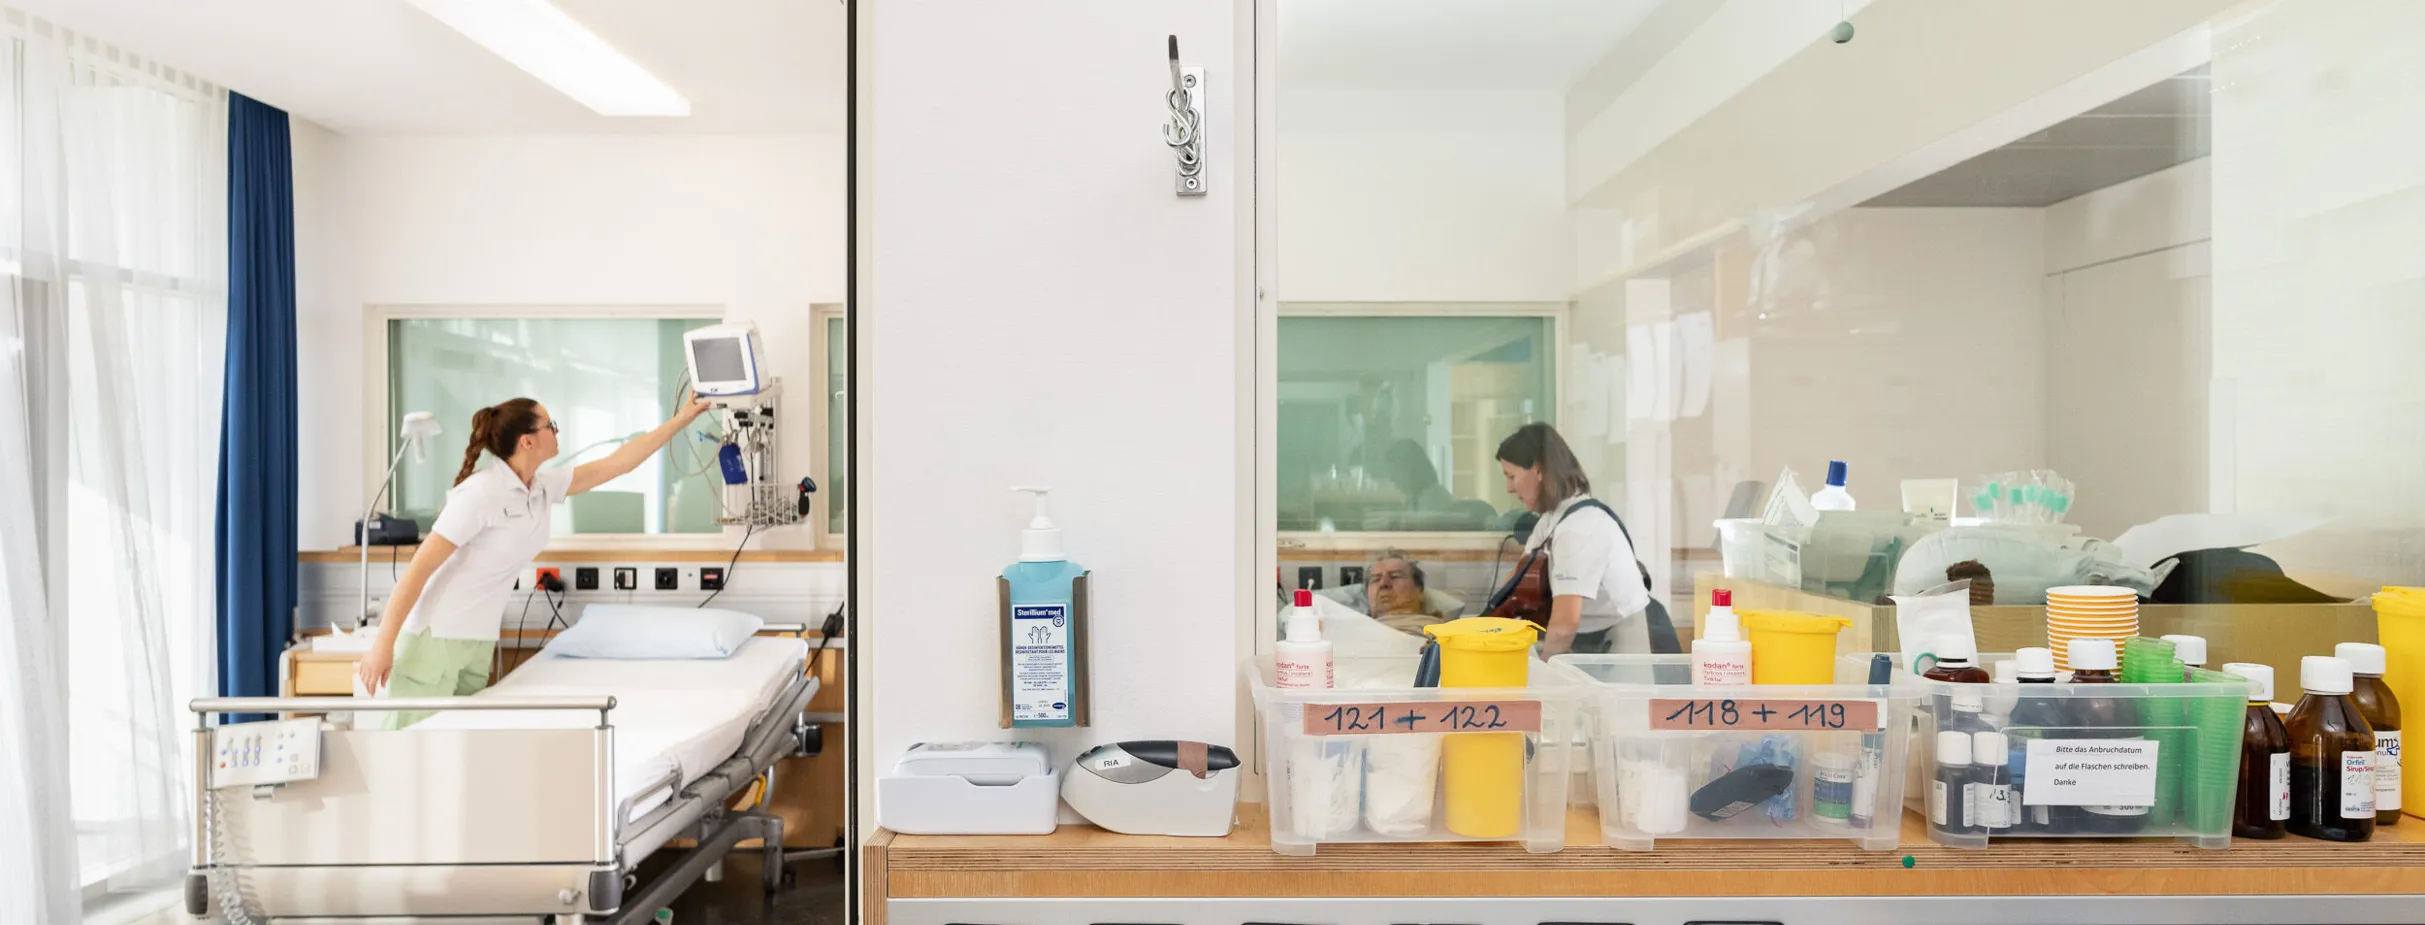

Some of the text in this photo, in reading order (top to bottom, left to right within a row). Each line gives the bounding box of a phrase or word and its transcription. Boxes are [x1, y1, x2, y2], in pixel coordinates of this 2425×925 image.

[1048, 608, 1062, 616] med
[1324, 704, 1507, 731] 121 + 122
[1666, 699, 1845, 729] 118 + 119
[2056, 745, 2142, 754] Bitte das Anbruchdatum
[1103, 759, 1120, 768] RIA
[2054, 778, 2077, 786] Danke
